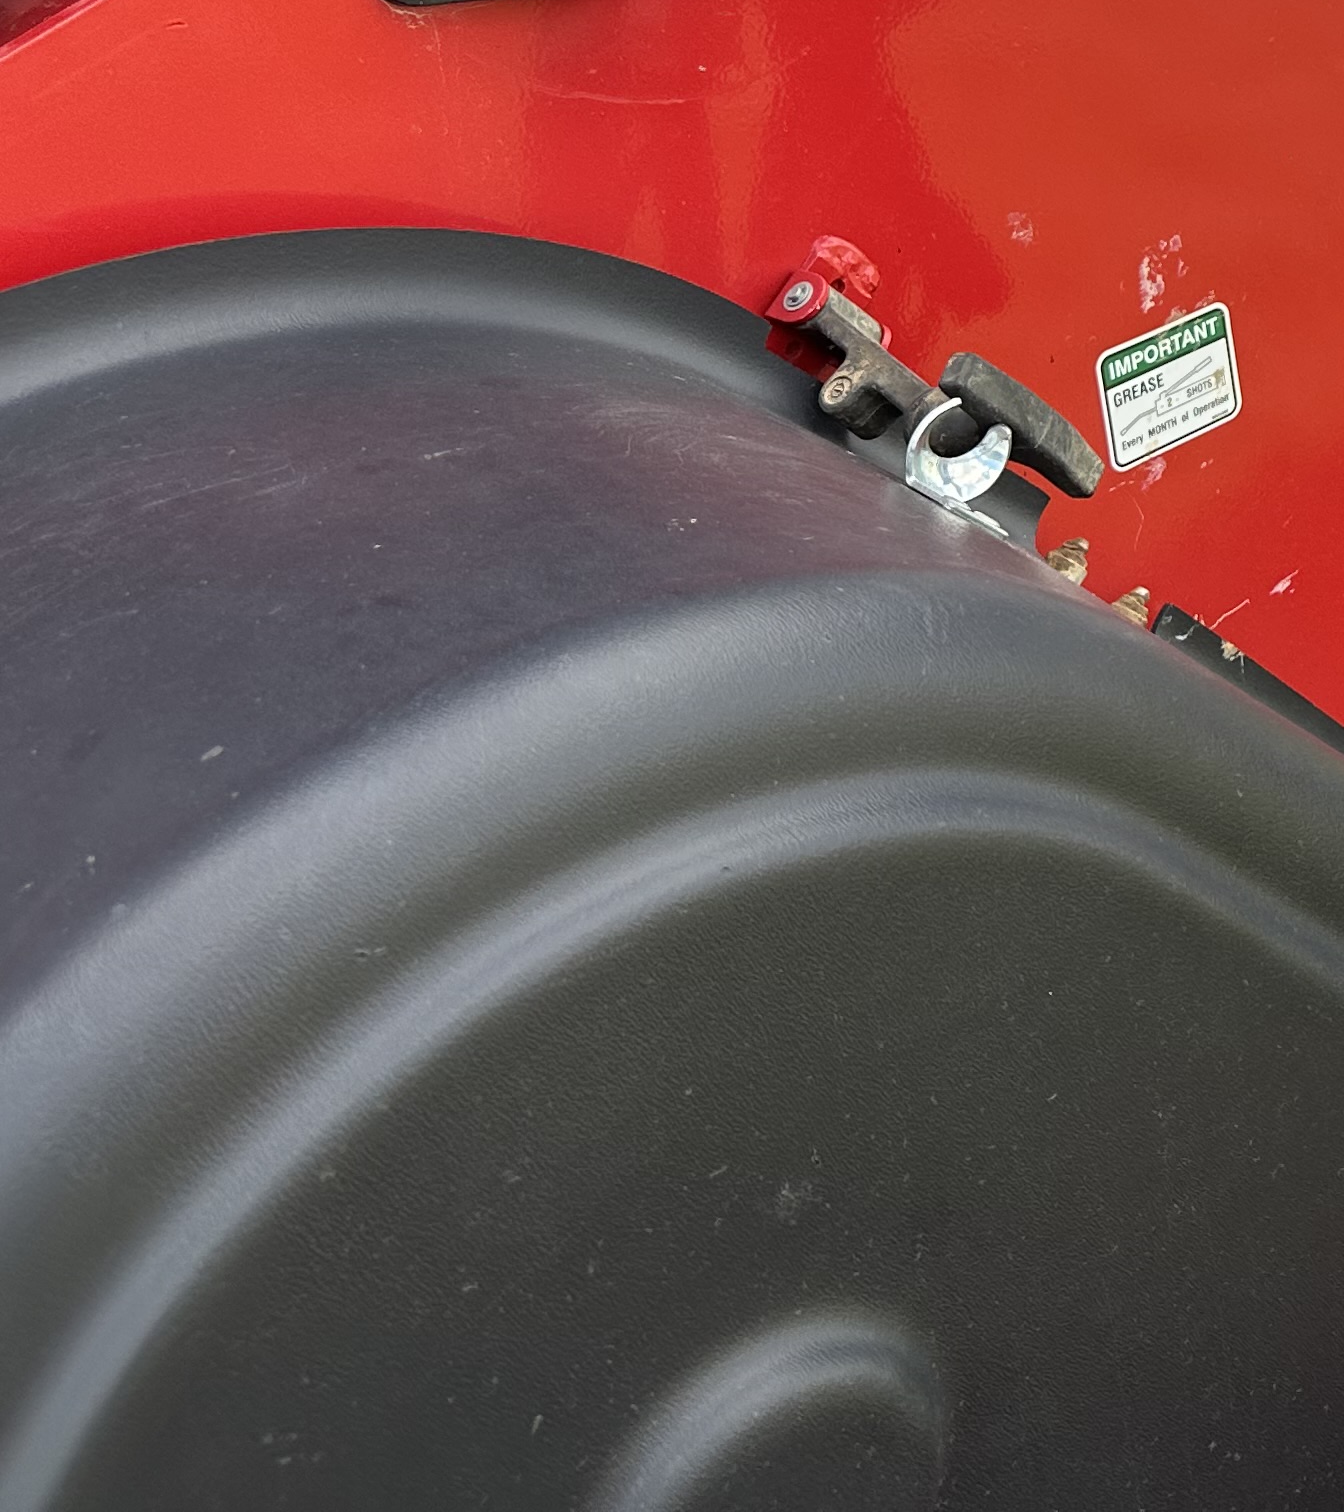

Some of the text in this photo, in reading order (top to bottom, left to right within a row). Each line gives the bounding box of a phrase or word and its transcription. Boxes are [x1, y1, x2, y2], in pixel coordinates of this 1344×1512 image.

[1107, 316, 1218, 381] IMPORTANT
[1113, 372, 1165, 408] GREASE
[1186, 378, 1213, 398] SHOTS
[1121, 434, 1145, 451] Every
[1147, 416, 1178, 438] MONTH
[1193, 393, 1231, 417] Operation
